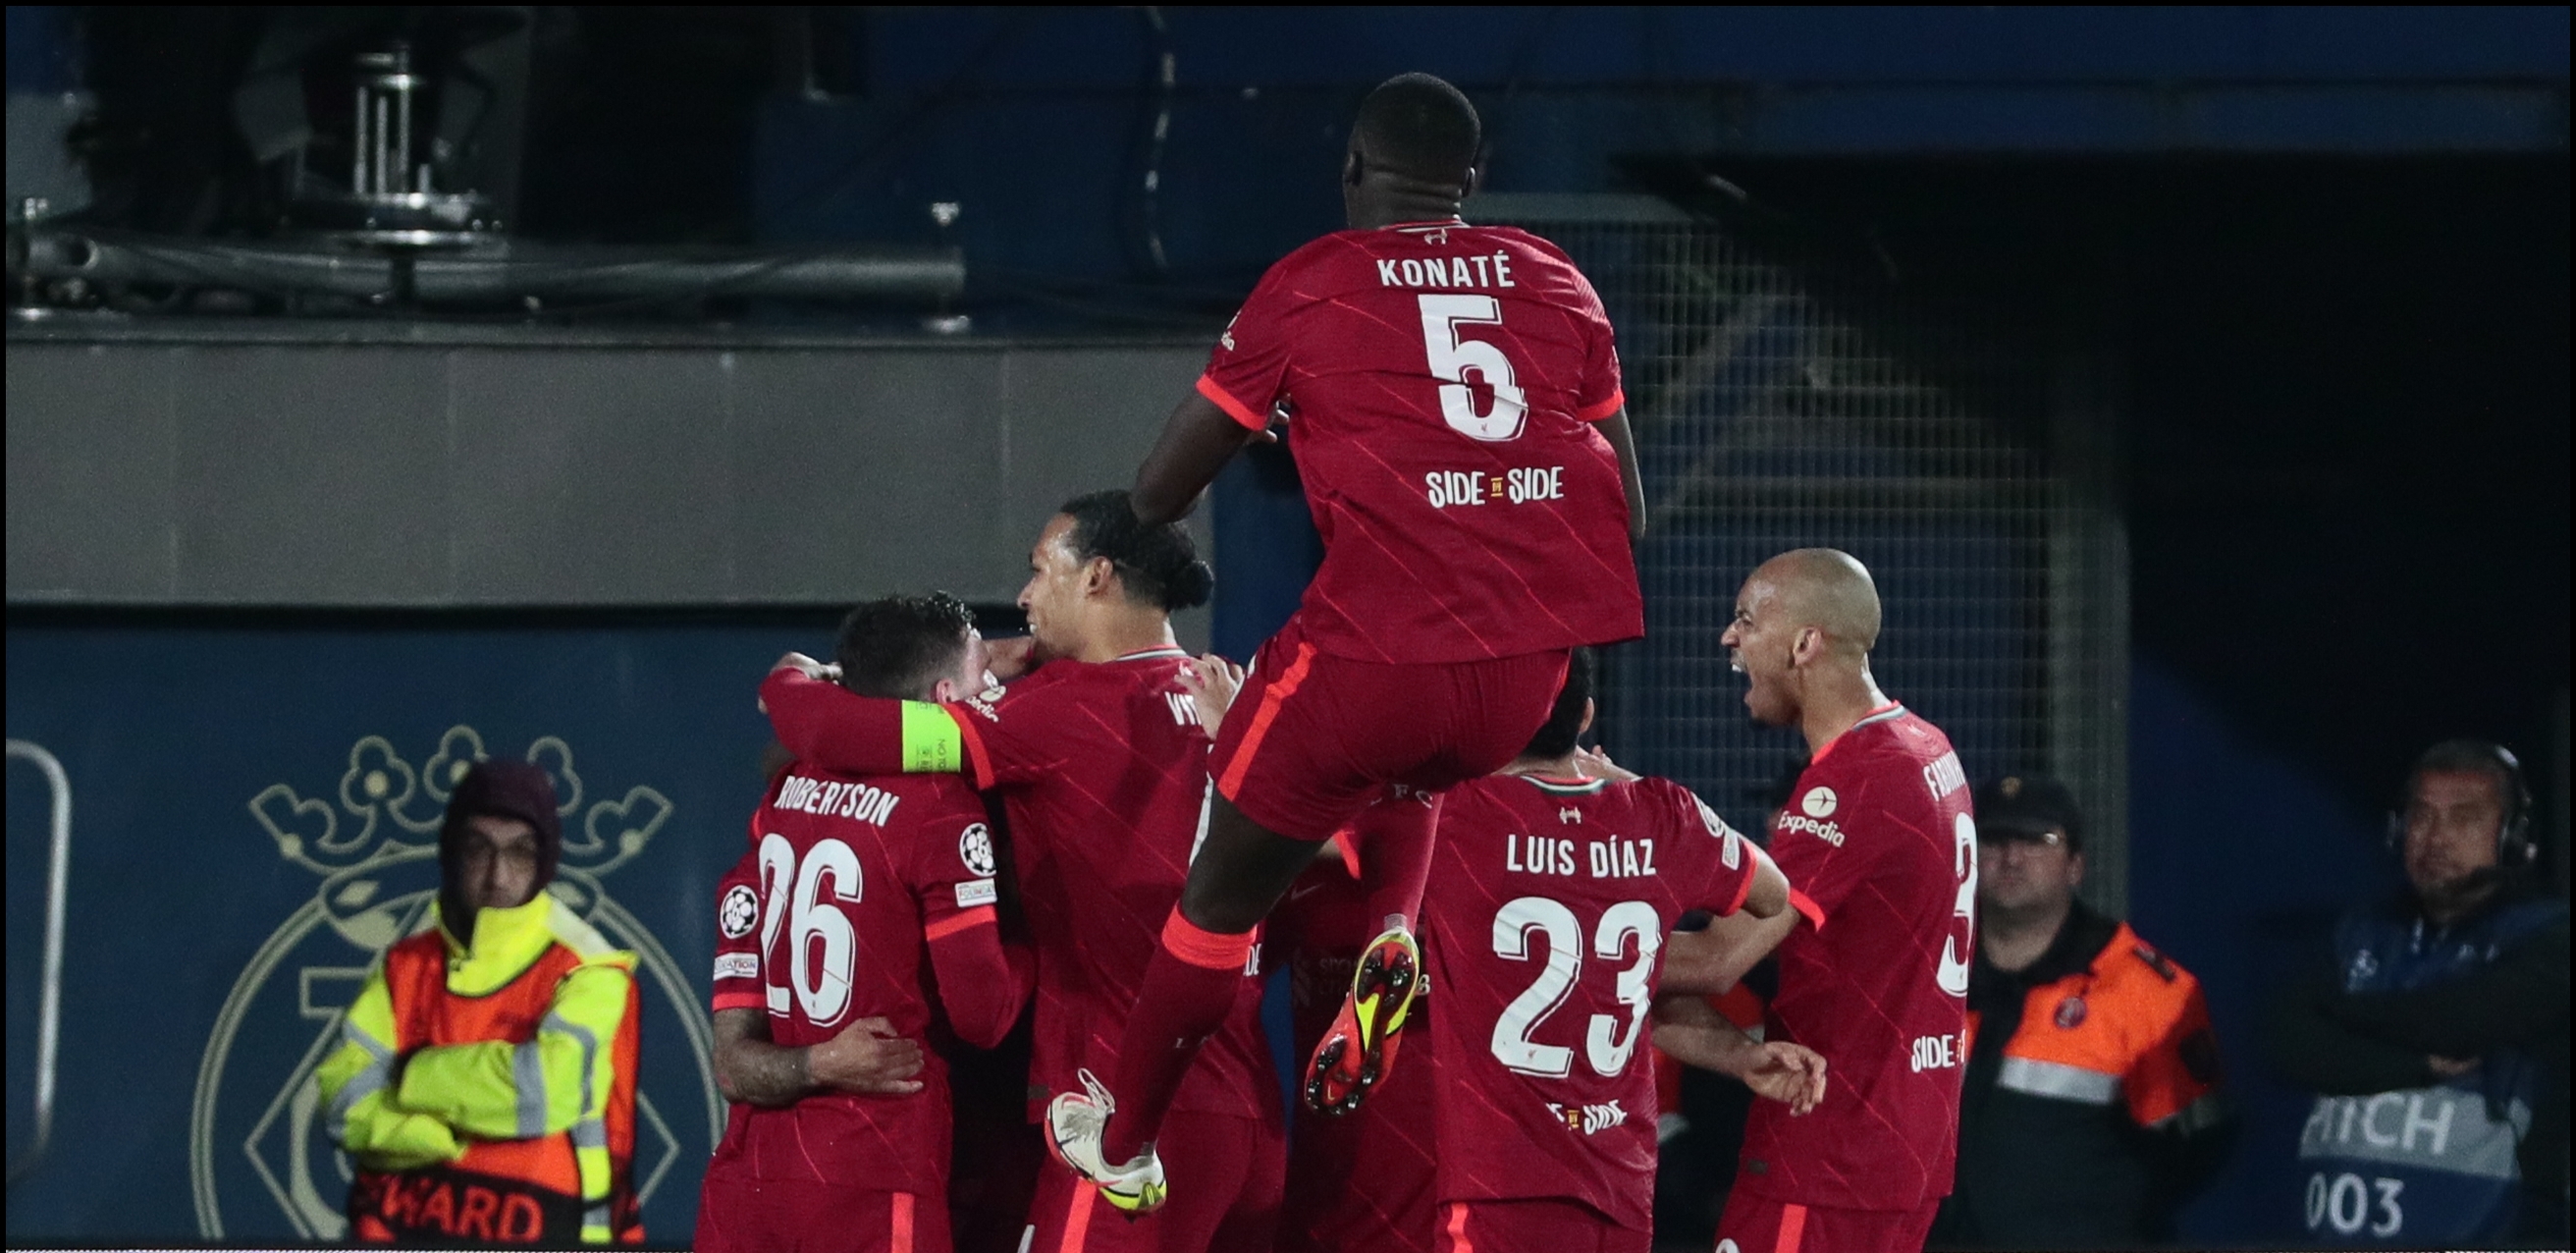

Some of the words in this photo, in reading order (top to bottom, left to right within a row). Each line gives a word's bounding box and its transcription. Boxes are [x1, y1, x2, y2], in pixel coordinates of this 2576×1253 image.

[1377, 249, 1516, 288] KONATÉ
[1418, 294, 1529, 442] 5
[1425, 470, 1486, 509] SIDE
[1507, 465, 1565, 505] SIDE
[774, 776, 900, 827] ROBERTSON
[1778, 810, 1846, 848] Expedia
[1507, 834, 1577, 877] LUIS
[1589, 835, 1657, 878] DÍAZ
[1937, 811, 1978, 998] 3
[759, 833, 864, 1027] 26
[1490, 896, 1663, 1078] 23
[1910, 1034, 1957, 1073] SIDE
[1583, 1099, 1628, 1136] SIDE
[2305, 1172, 2406, 1237] 003
